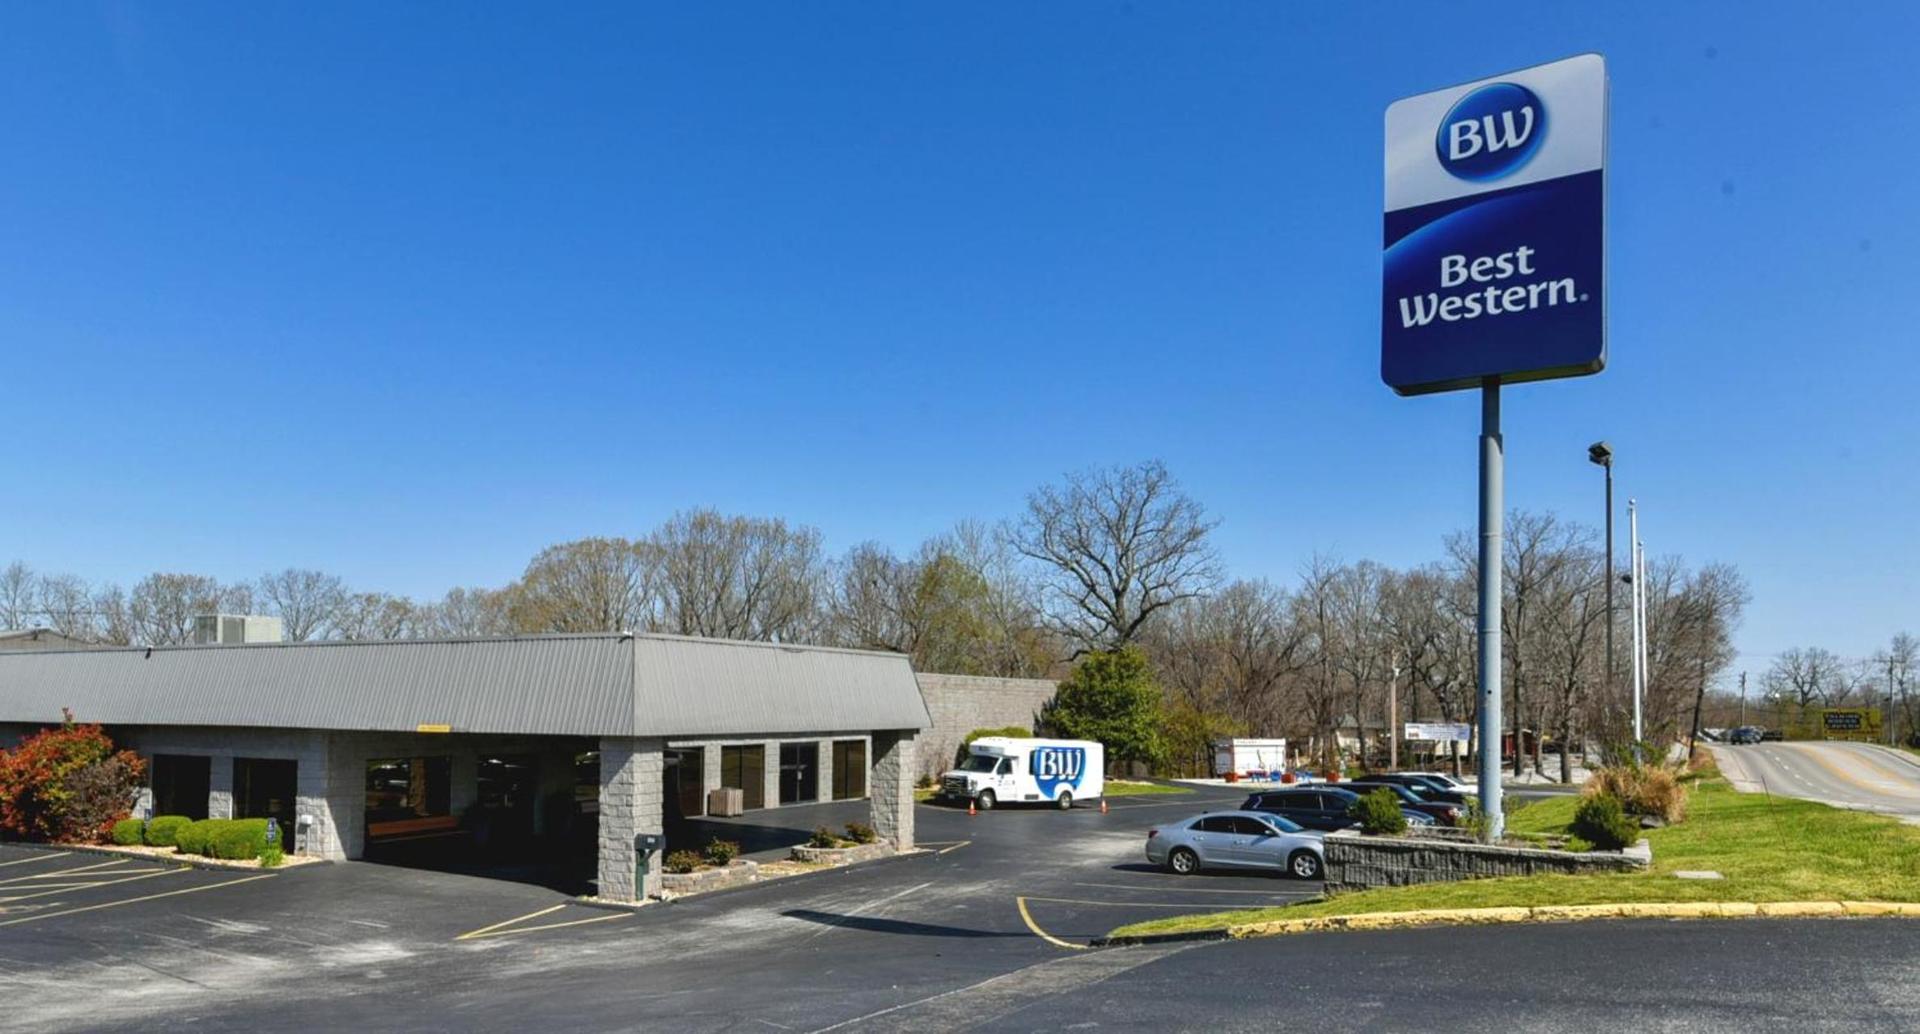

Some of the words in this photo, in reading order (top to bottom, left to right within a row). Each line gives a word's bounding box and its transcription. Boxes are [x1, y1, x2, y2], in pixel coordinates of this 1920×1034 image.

[1449, 105, 1535, 161] BW
[1440, 245, 1536, 288] Best
[1398, 276, 1578, 328] Western
[1038, 748, 1082, 781] BW
